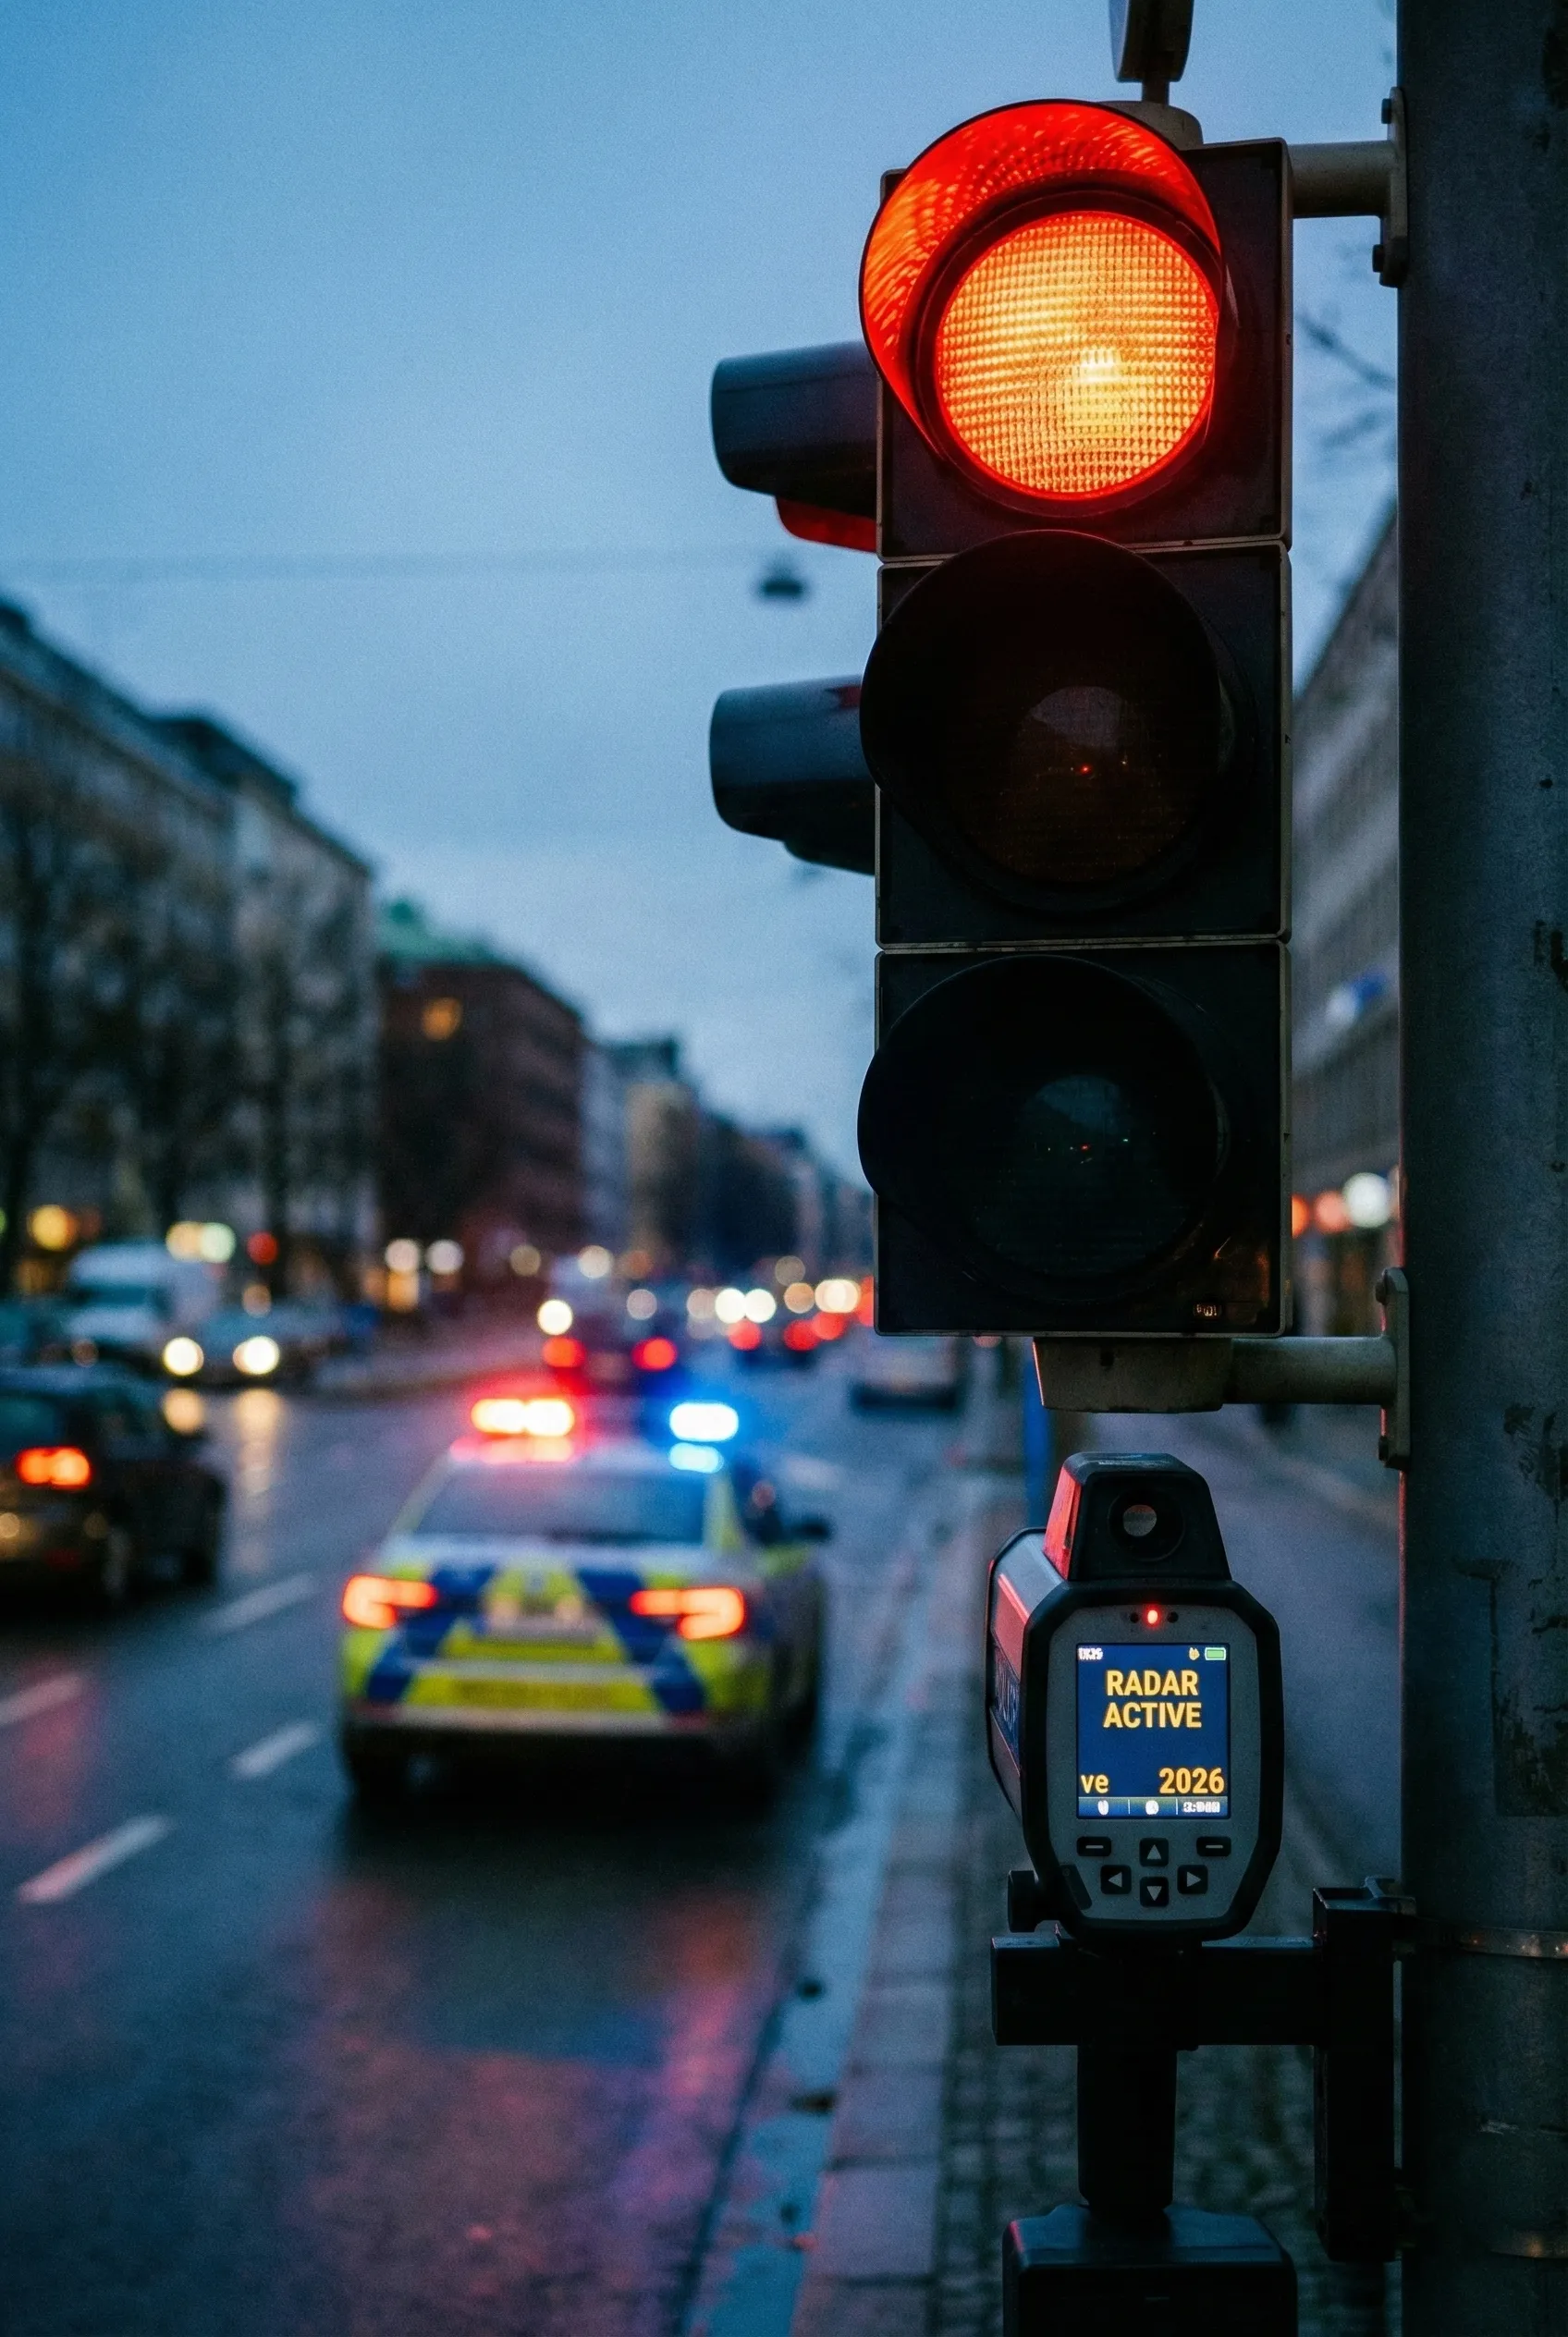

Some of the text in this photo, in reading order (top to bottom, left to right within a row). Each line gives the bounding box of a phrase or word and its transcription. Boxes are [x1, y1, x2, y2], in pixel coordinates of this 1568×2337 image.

[1106, 1669, 1199, 1696] RADAR
[1103, 1701, 1202, 1729] ACTIVE
[1080, 1767, 1225, 1794] ve 2026
